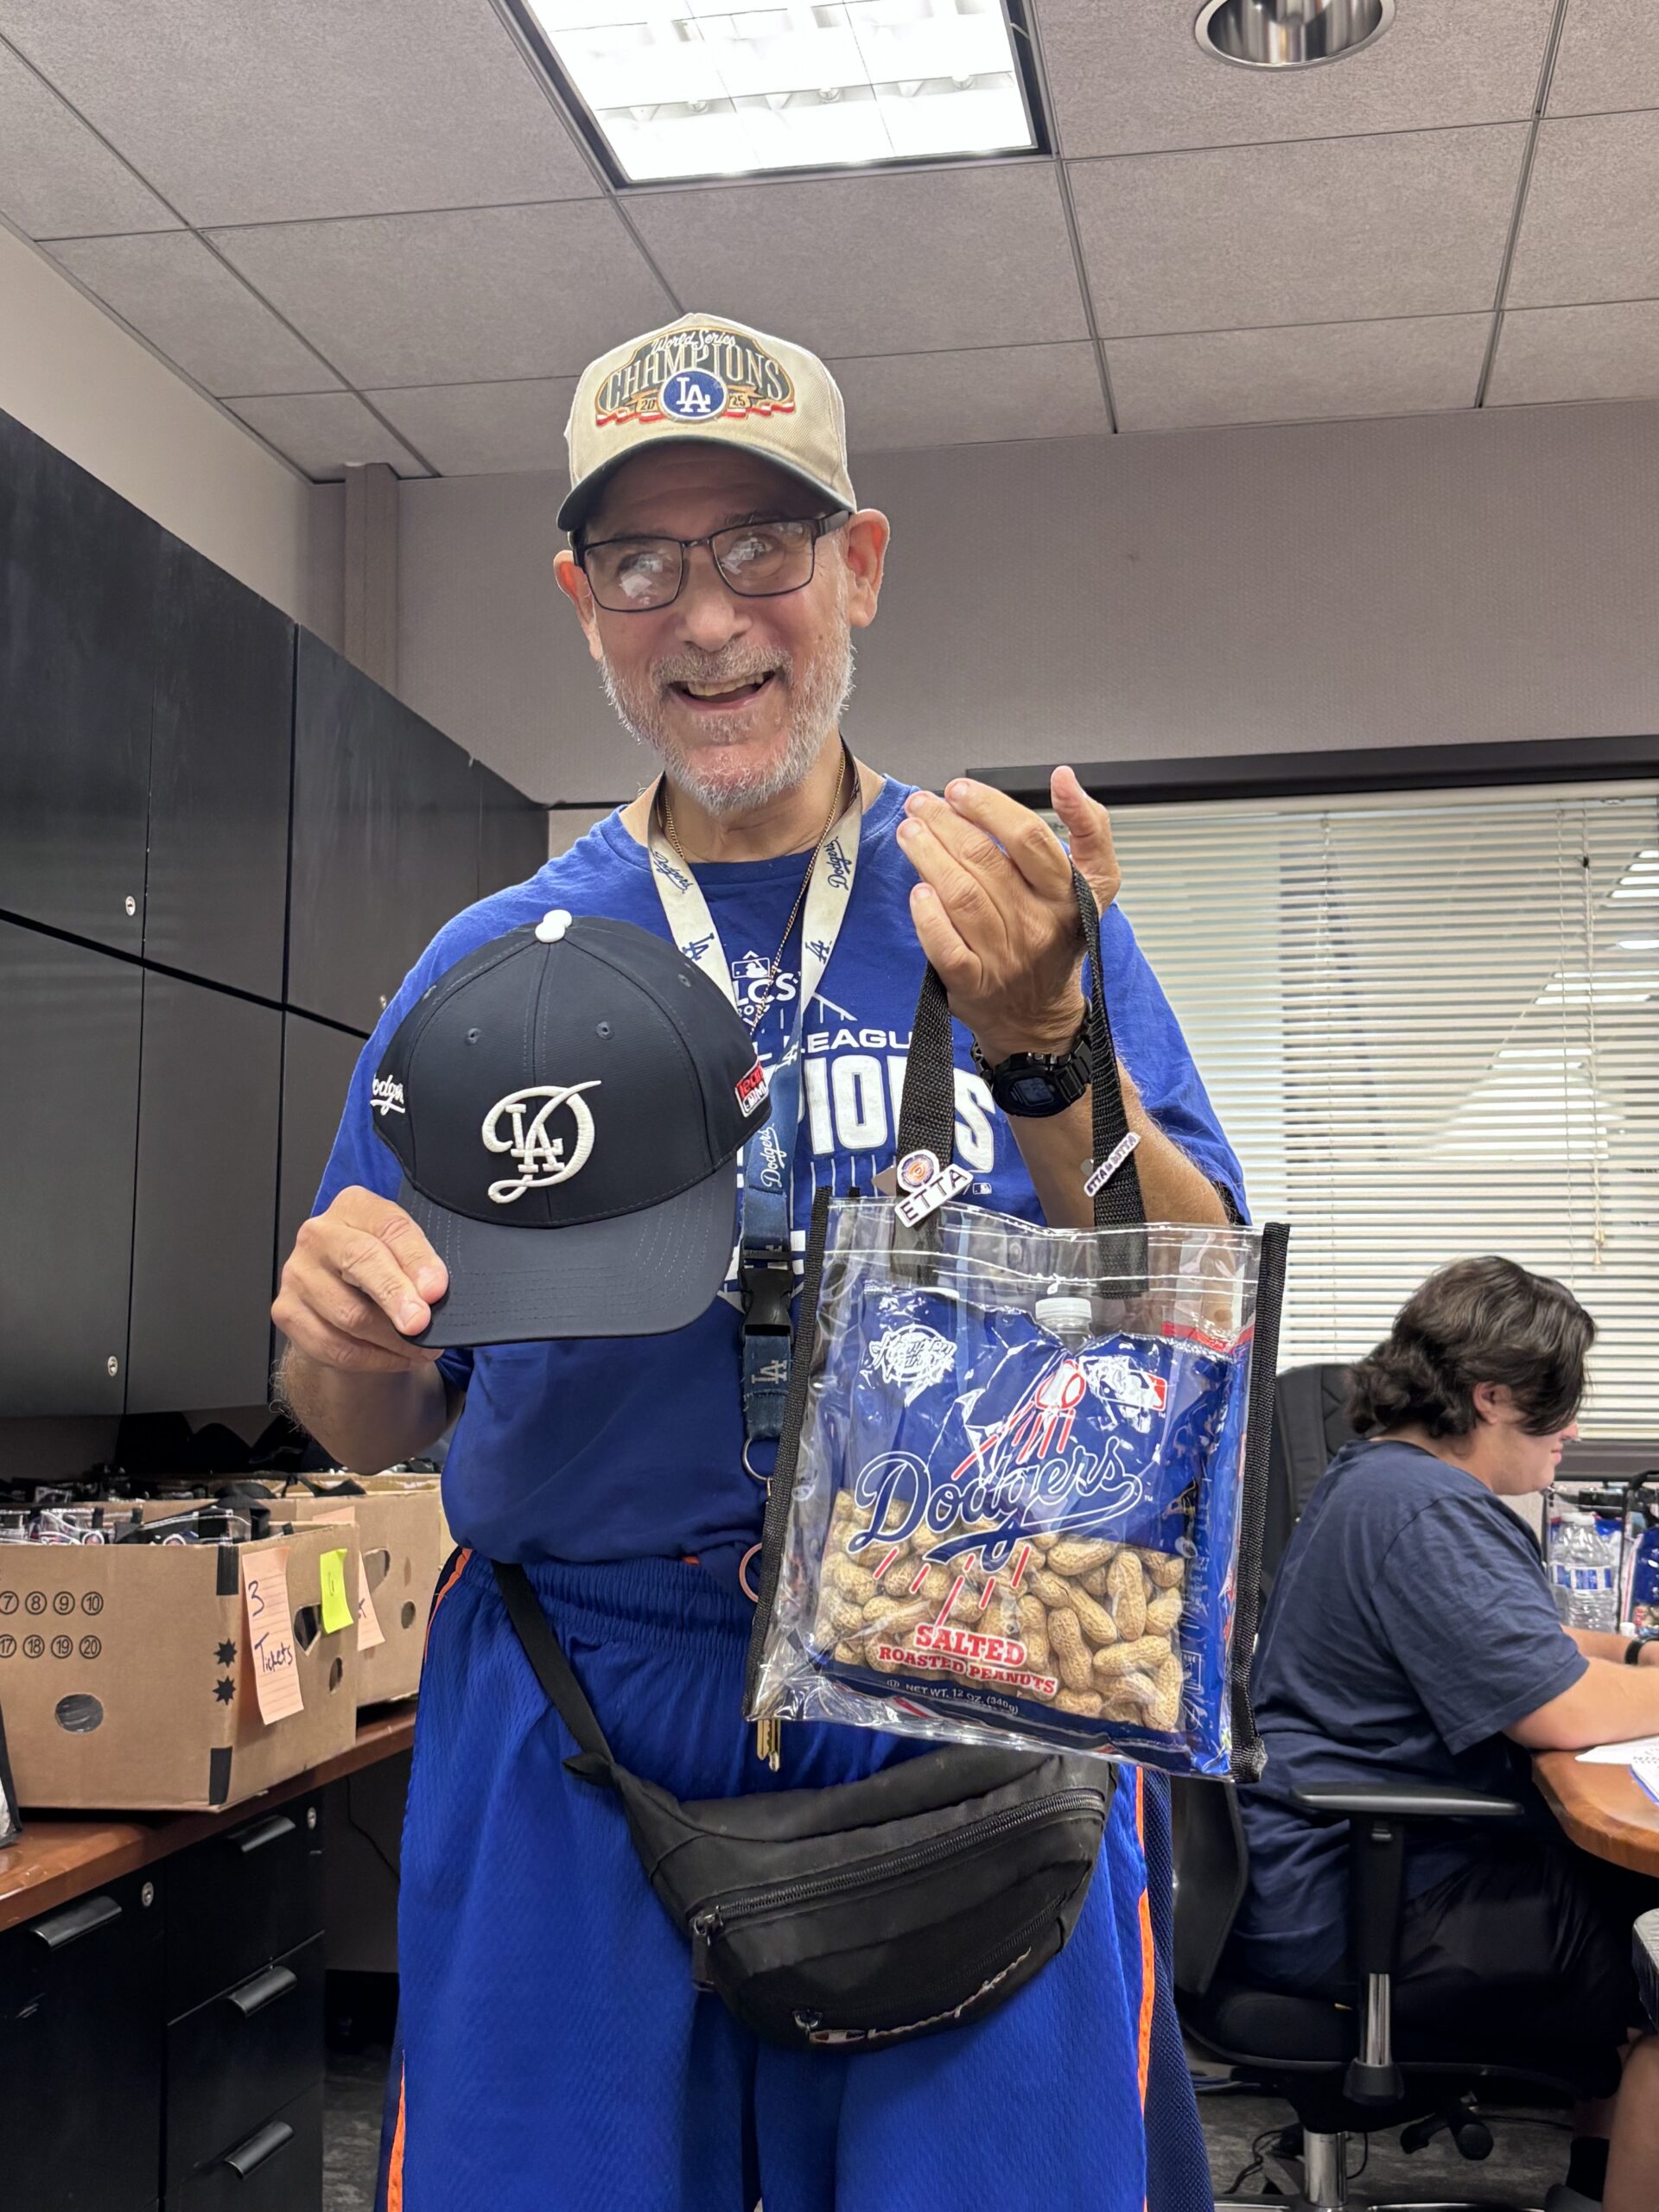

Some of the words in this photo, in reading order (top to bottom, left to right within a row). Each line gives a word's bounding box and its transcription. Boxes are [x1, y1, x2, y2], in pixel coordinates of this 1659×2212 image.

[651, 332, 696, 354] World
[691, 329, 736, 351] Series
[607, 343, 783, 411] CHAMPIONS
[640, 398, 656, 410] 20
[677, 377, 711, 413] LA
[730, 394, 746, 407] 25
[650, 848, 693, 893] Dodgers
[823, 836, 852, 892] Dodgers
[682, 932, 715, 961] LA
[804, 940, 830, 964] LA
[733, 973, 796, 1007] LCS
[758, 1123, 787, 1188] Dodgers
[899, 1168, 969, 1222] ETTA
[750, 1358, 789, 1384] LA
[848, 1436, 1143, 1572] Dodgers
[85, 1594, 101, 1612] 10
[248, 1580, 265, 1618] 3
[0, 1637, 14, 1655] 17
[27, 1637, 42, 1656] 18
[55, 1637, 71, 1656] 19
[82, 1638, 99, 1656] 20
[915, 1624, 1026, 1666] SALTED
[879, 1646, 964, 1673] ROASTED
[968, 1664, 1056, 1694] PEANUTS
[906, 1684, 927, 1695] NET
[931, 1687, 950, 1699] WT.
[952, 1688, 964, 1698] 12
[966, 1693, 984, 1703] OZ.
[986, 1695, 1019, 1715] (340g)
